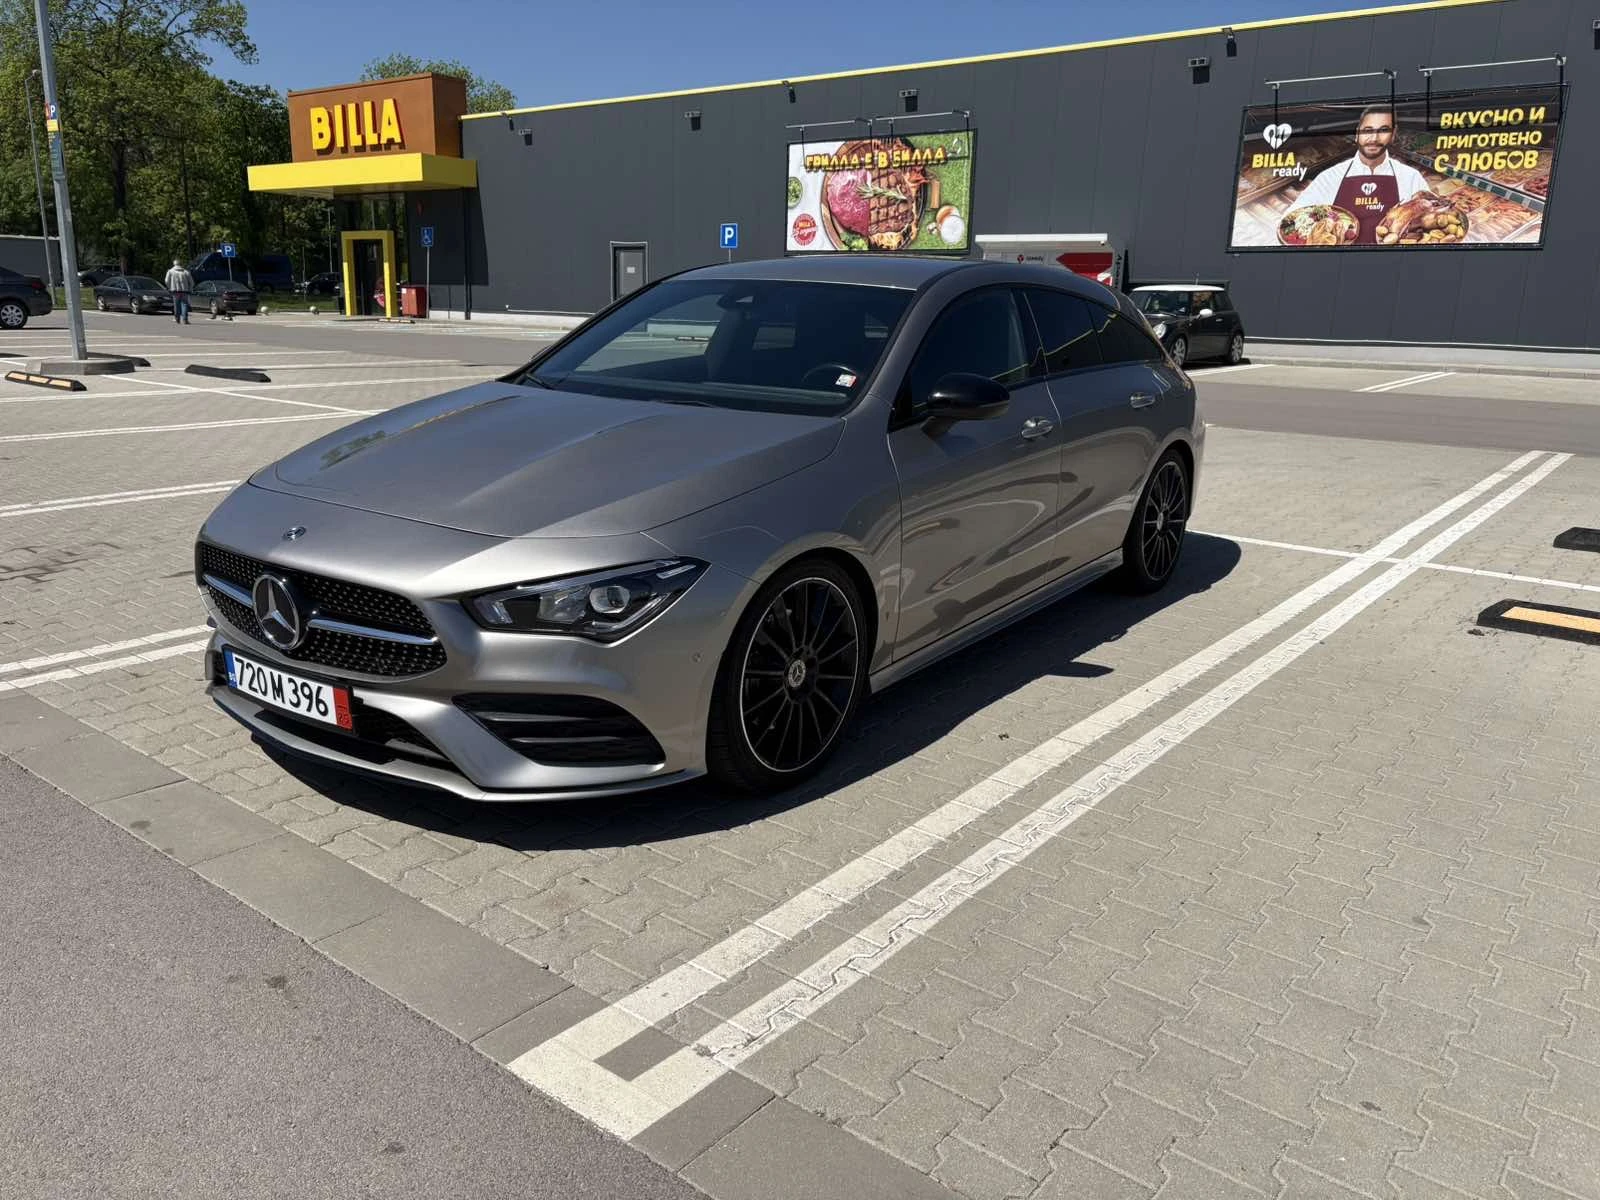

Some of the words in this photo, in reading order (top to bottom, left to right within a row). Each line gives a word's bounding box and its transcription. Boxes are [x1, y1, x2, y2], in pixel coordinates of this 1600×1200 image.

[310, 98, 403, 151] BILLA
[1440, 108, 1524, 129] ВКУСНО
[1529, 106, 1546, 126] И
[1436, 130, 1542, 149] ПРИГОТВЕНО
[878, 150, 889, 168] В
[1252, 151, 1296, 168] BILLA
[1434, 153, 1450, 173] С
[1453, 149, 1539, 172] ЛЮБОВ
[1272, 162, 1308, 181] ready
[1355, 196, 1379, 206] BILLA
[1366, 202, 1385, 212] ready
[725, 227, 734, 245] P
[235, 657, 268, 697] 720
[270, 671, 286, 704] M
[287, 677, 329, 717] 396
